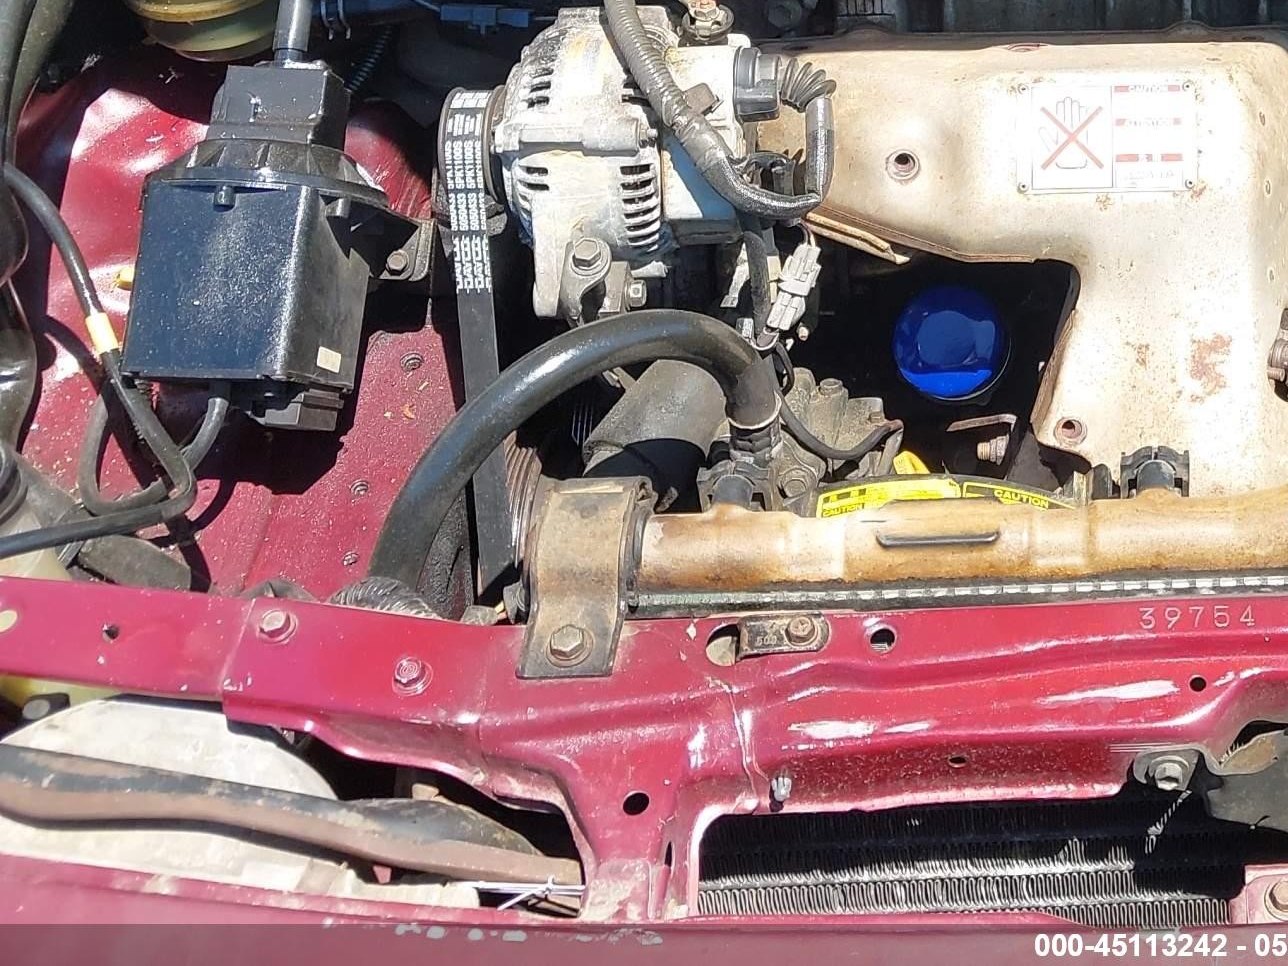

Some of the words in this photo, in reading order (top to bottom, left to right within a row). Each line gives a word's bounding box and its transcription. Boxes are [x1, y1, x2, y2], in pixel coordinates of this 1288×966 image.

[993, 488, 1050, 509] CAUTION
[821, 502, 866, 519] CAUTION
[1138, 605, 1256, 630] 39754
